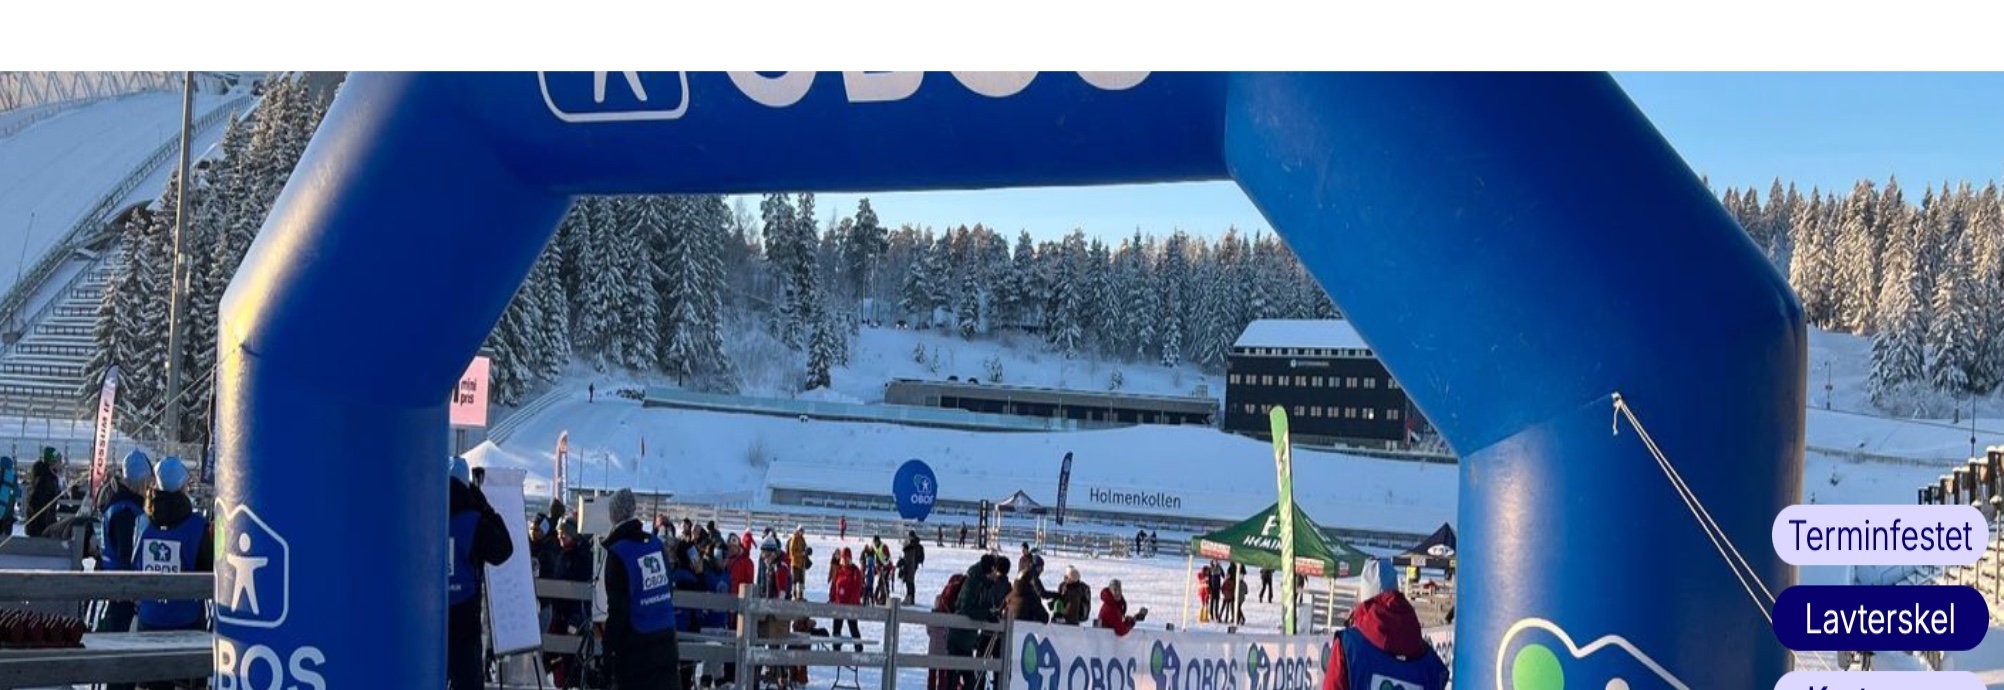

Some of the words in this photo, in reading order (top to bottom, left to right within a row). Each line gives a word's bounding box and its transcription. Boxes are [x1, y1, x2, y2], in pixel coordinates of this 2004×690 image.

[1090, 487, 1181, 509] Holmenkollen
[1243, 535, 1284, 550] HEMIN
[212, 638, 327, 690] BOS
